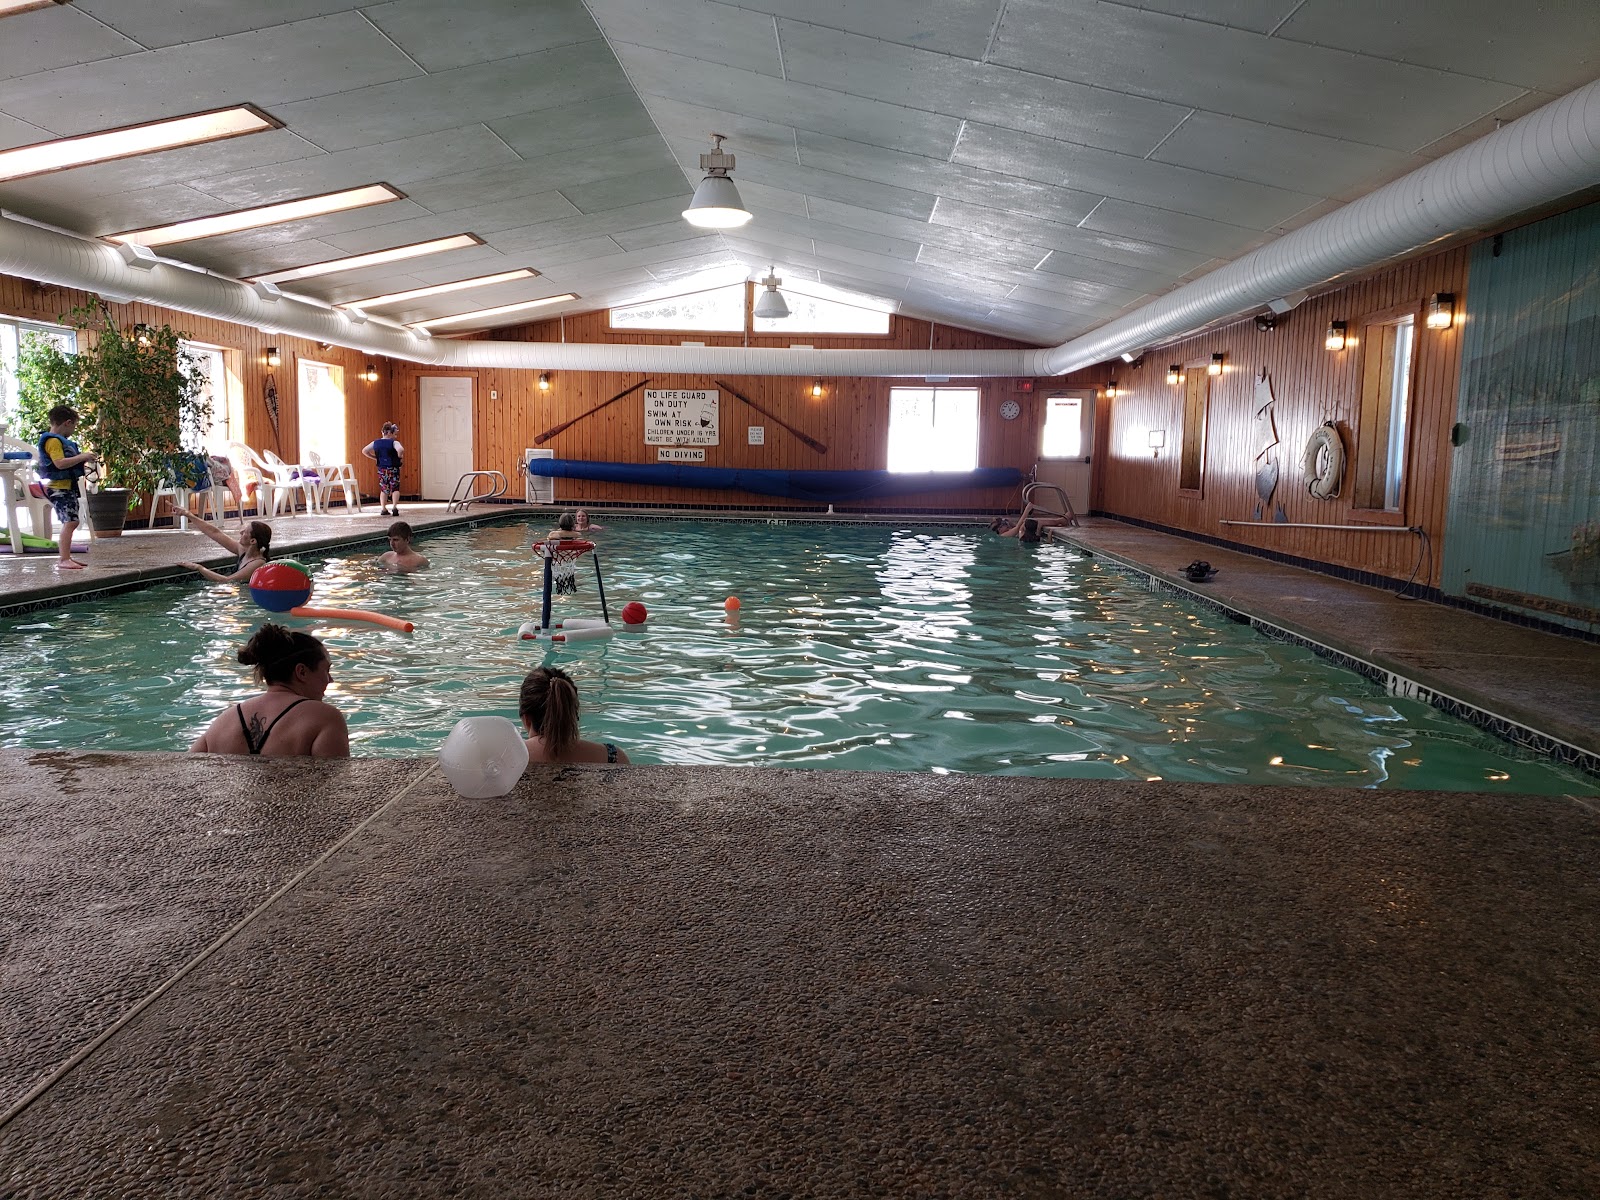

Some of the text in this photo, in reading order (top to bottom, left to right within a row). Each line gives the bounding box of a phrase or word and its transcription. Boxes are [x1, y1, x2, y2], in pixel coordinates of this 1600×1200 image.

[647, 391, 706, 400] NO LIFE GUARD
[668, 400, 688, 408] DUTY
[647, 410, 668, 418] SWIM
[675, 419, 692, 427] RISK
[647, 428, 674, 436] CHILDREN
[660, 450, 703, 459] NO DIVING
